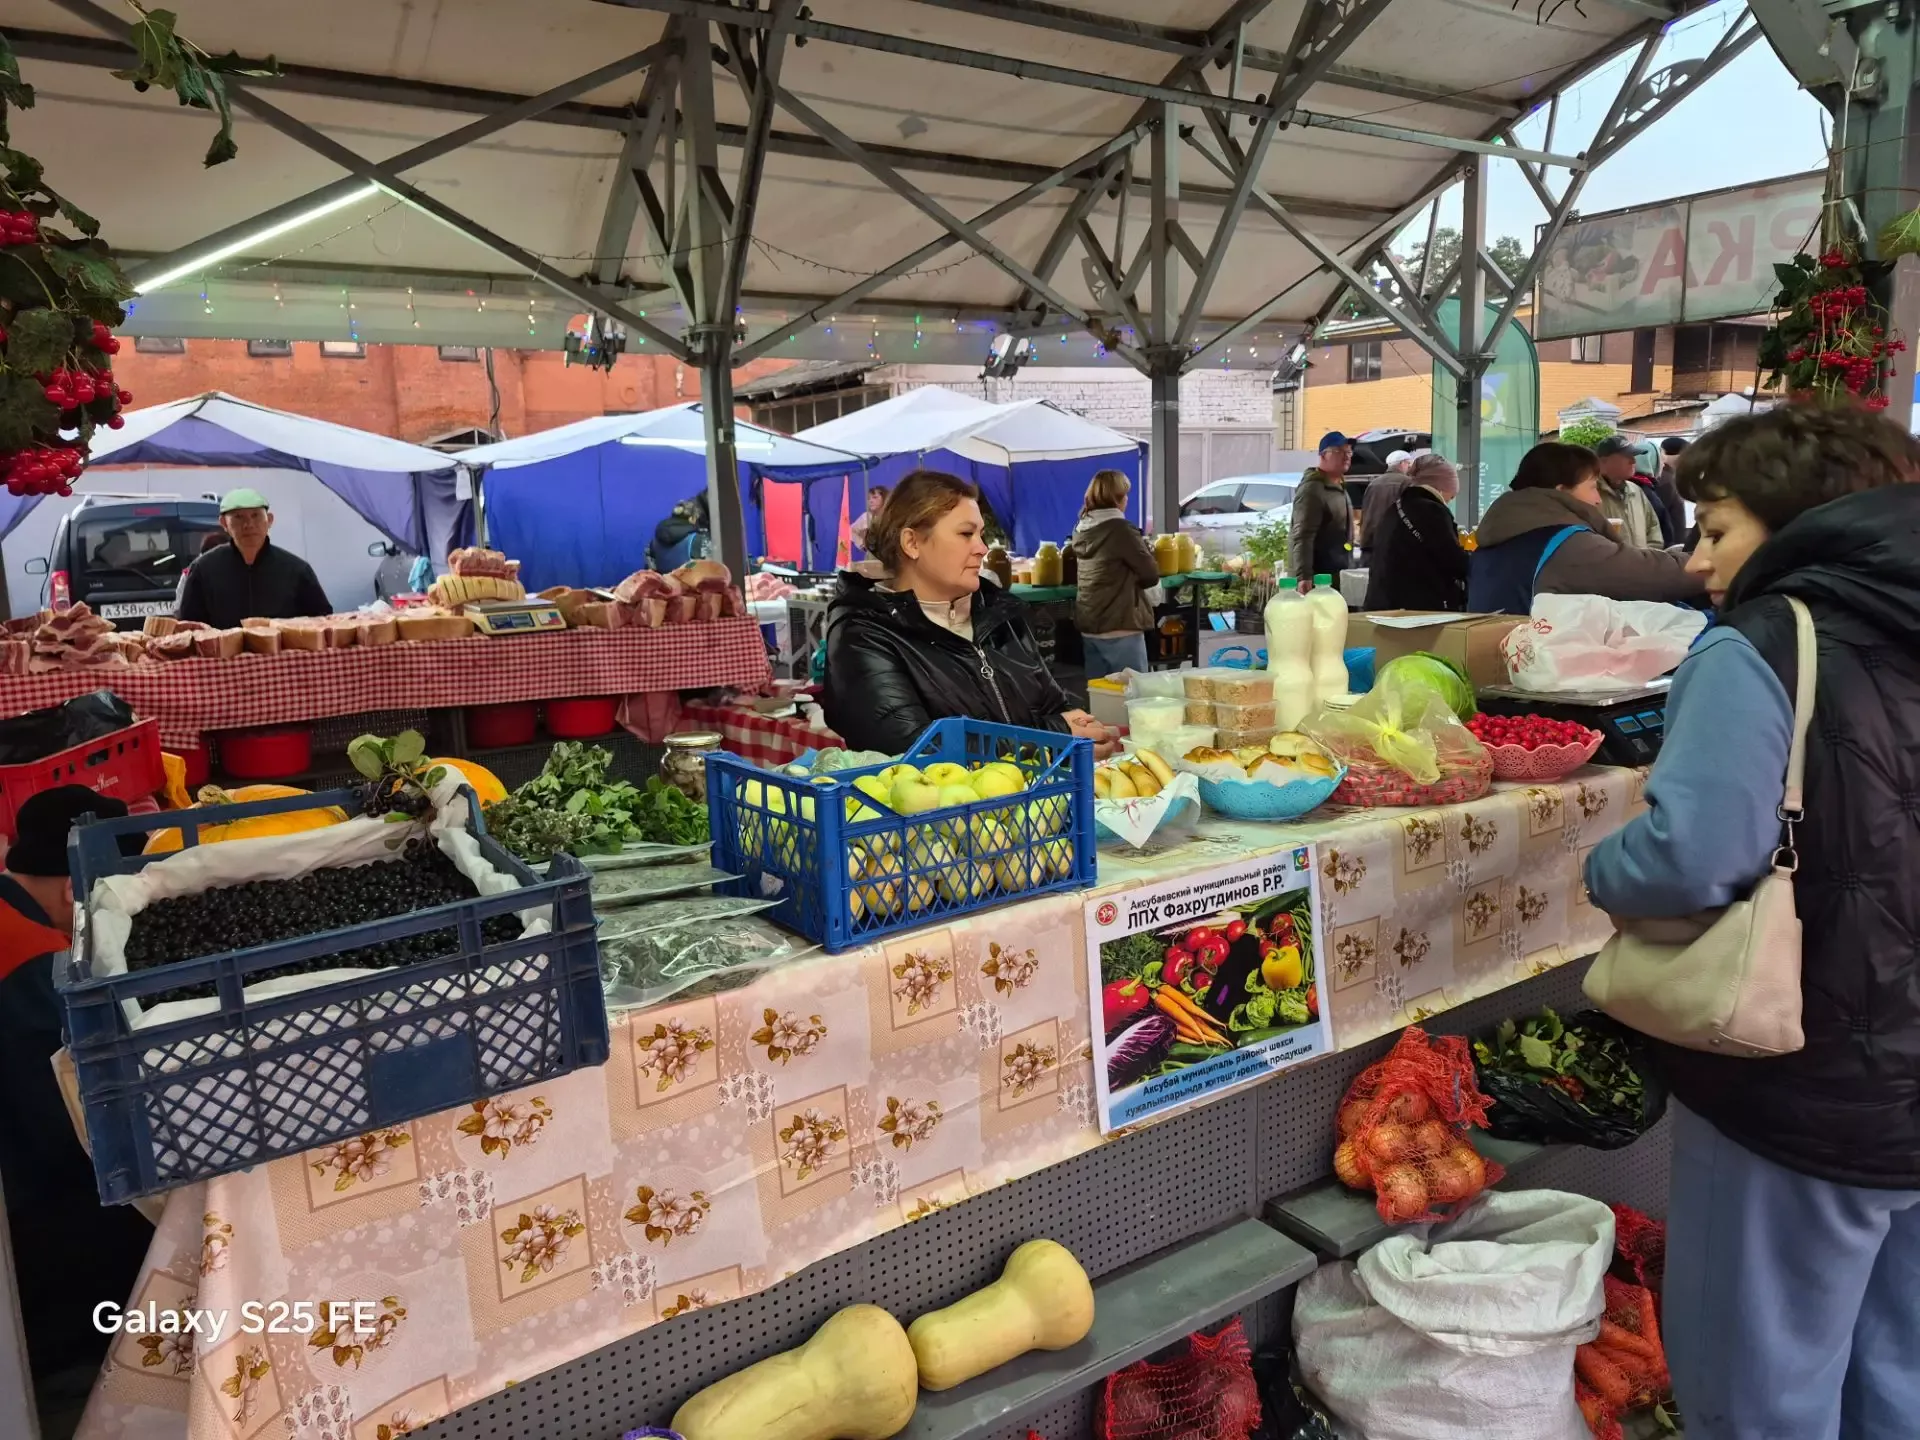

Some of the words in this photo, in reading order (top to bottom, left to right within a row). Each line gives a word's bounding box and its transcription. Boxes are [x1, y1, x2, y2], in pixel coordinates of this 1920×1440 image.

[1128, 907, 1160, 929] ЛПХ
[1163, 884, 1259, 918] Фахрутдинов
[1263, 875, 1285, 892] Р.Р.
[1130, 886, 1191, 911] Аксубаевский
[1193, 868, 1261, 896] муниципальный
[1262, 863, 1287, 878] район
[1143, 1075, 1179, 1096] Аксубай
[1181, 1059, 1234, 1082] муниципаль
[1236, 1046, 1267, 1064] районы
[1270, 1044, 1313, 1065] продукция
